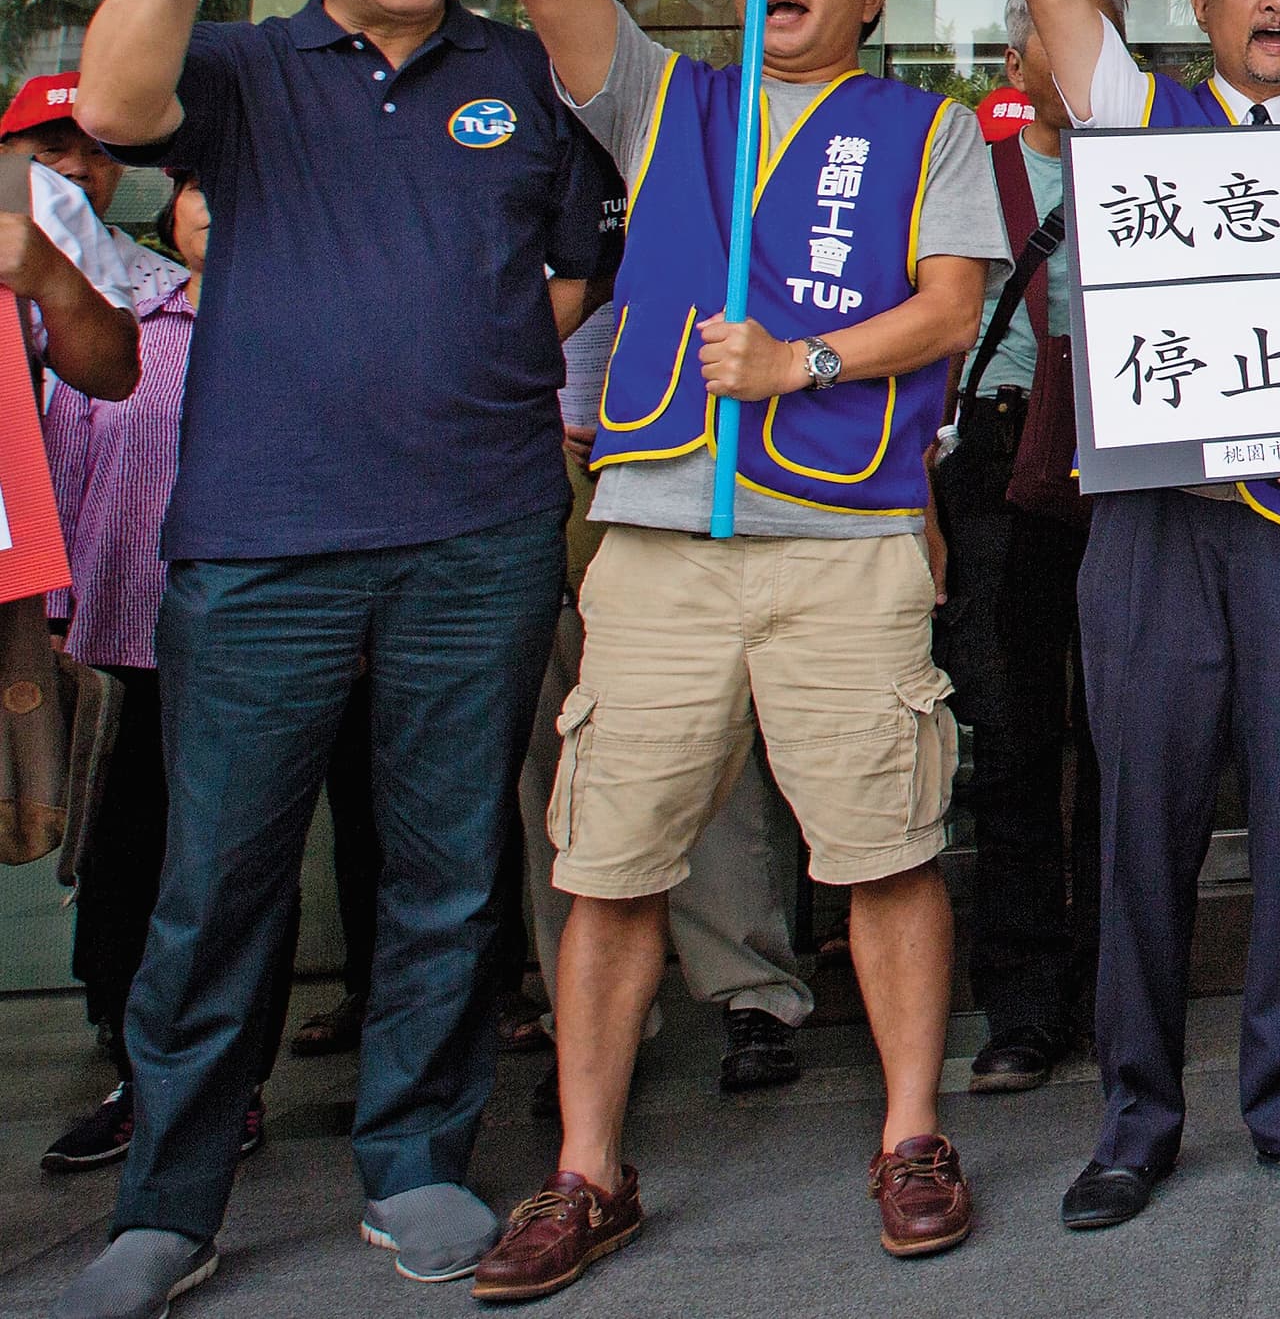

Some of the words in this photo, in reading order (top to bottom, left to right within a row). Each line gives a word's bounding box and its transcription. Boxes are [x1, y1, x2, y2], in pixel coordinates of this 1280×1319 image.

[457, 116, 516, 135] TUP
[810, 136, 870, 278] 機師工會
[787, 278, 863, 314] TUP
